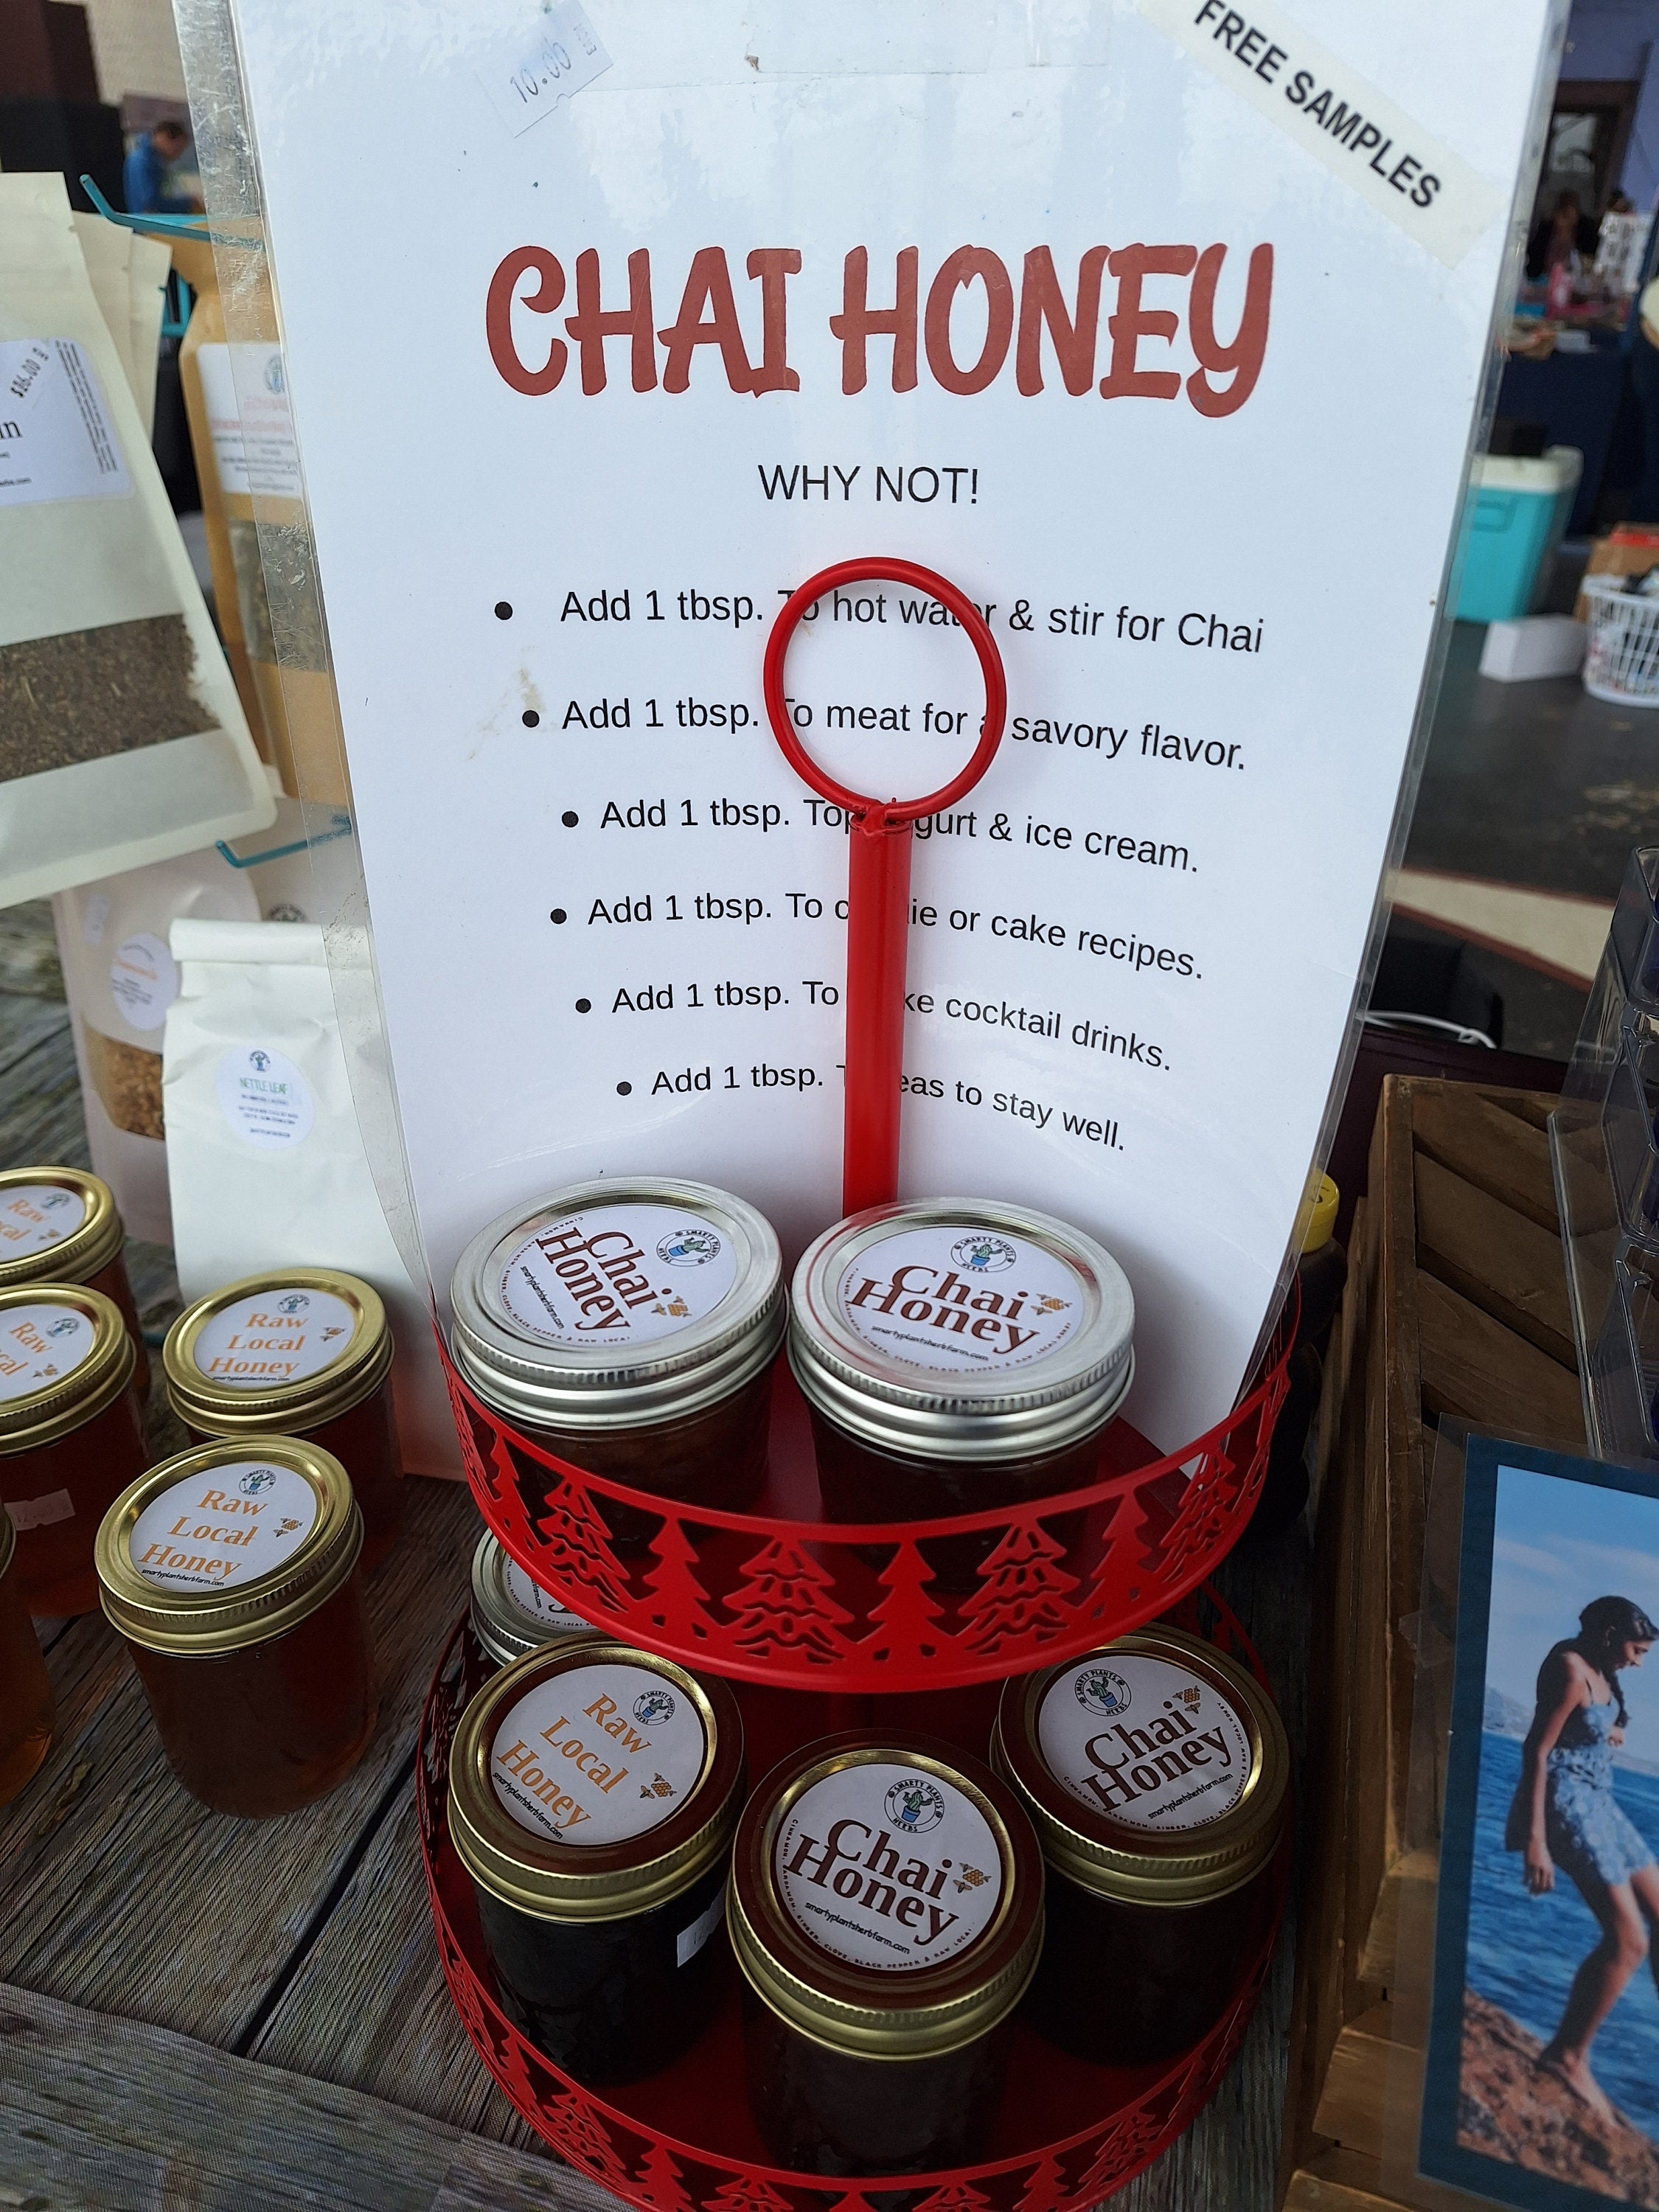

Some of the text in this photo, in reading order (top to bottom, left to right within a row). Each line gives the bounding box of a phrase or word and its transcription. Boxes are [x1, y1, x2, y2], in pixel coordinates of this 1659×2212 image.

[509, 41, 571, 103] 10.00
[1194, 0, 1441, 208] FREE SAMPLES
[487, 243, 1273, 417] CHAI HONEY
[758, 464, 978, 504] WHY NOT!
[560, 590, 630, 622] Add
[647, 590, 664, 621] 1
[678, 589, 763, 628] tbsp.
[833, 591, 886, 624] hot
[1009, 599, 1034, 632] &
[1048, 602, 1105, 637] stir
[1116, 605, 1165, 643] for
[1178, 612, 1265, 653] Chai
[563, 698, 630, 730] Add
[646, 699, 664, 728] 1
[676, 697, 759, 734] tbsp.
[827, 703, 911, 731] meat
[922, 702, 968, 735] for
[1012, 715, 1128, 759] savory
[1141, 724, 1245, 771] flavor.
[600, 799, 666, 829] Add
[681, 799, 698, 826] 1
[710, 798, 790, 832] tbsp.
[989, 813, 1012, 842] &
[1025, 815, 1072, 849] ice
[1084, 830, 1198, 872] cream.
[588, 895, 653, 925] Add
[665, 895, 684, 920] 1
[695, 892, 772, 925] tbsp.
[785, 893, 823, 919] To
[949, 908, 981, 932] or
[991, 914, 1066, 947] cake
[1078, 929, 1203, 979] recipes.
[611, 984, 674, 1014] Add
[686, 984, 704, 1008] 1
[714, 981, 790, 1011] tbsp.
[802, 981, 839, 1005] To
[945, 998, 1061, 1040] cocktail
[1071, 1020, 1171, 1071] drinks.
[651, 1067, 712, 1096] Add
[723, 1066, 740, 1089] 1
[751, 1063, 824, 1093] tbsp.
[956, 1080, 982, 1106] to
[992, 1092, 1053, 1130] stay
[1062, 1110, 1124, 1152] well.
[535, 1226, 631, 1331] Honey
[585, 1231, 672, 1310] Chai
[891, 1265, 1029, 1321] Chai
[10, 1322, 53, 1353] Raw
[226, 1334, 306, 1352] Local
[245, 1313, 310, 1329] Raw
[844, 1276, 1041, 1355] Honey
[207, 1357, 301, 1377] Honey
[167, 1515, 259, 1546] Local
[196, 1489, 269, 1517] Raw
[137, 1543, 243, 1581] Honey
[141, 1568, 225, 1587] smartyplantsherbfarm.com
[1074, 1669, 1118, 1697] SMARTY PLANTS
[1106, 1702, 1128, 1716] HERBS
[1217, 1701, 1234, 1723] HONEY
[582, 1692, 653, 1755] Raw
[1085, 1700, 1197, 1771] Chai
[1232, 1723, 1244, 1745] LOCAL
[496, 1739, 592, 1830] Honey
[540, 1715, 630, 1795] Local
[1081, 1726, 1232, 1813] Honey
[493, 1771, 564, 1840] smartyplantsherbfarm.com
[892, 1817, 919, 1833] HERBS
[894, 1779, 944, 1810] SMARTY PLANTS
[1147, 1772, 1234, 1820] smartyplantsherbfarm.com
[782, 1833, 961, 1947] Honey
[827, 1818, 953, 1900] Chai
[804, 1901, 911, 1955] smartyplantsherbfarm.com
